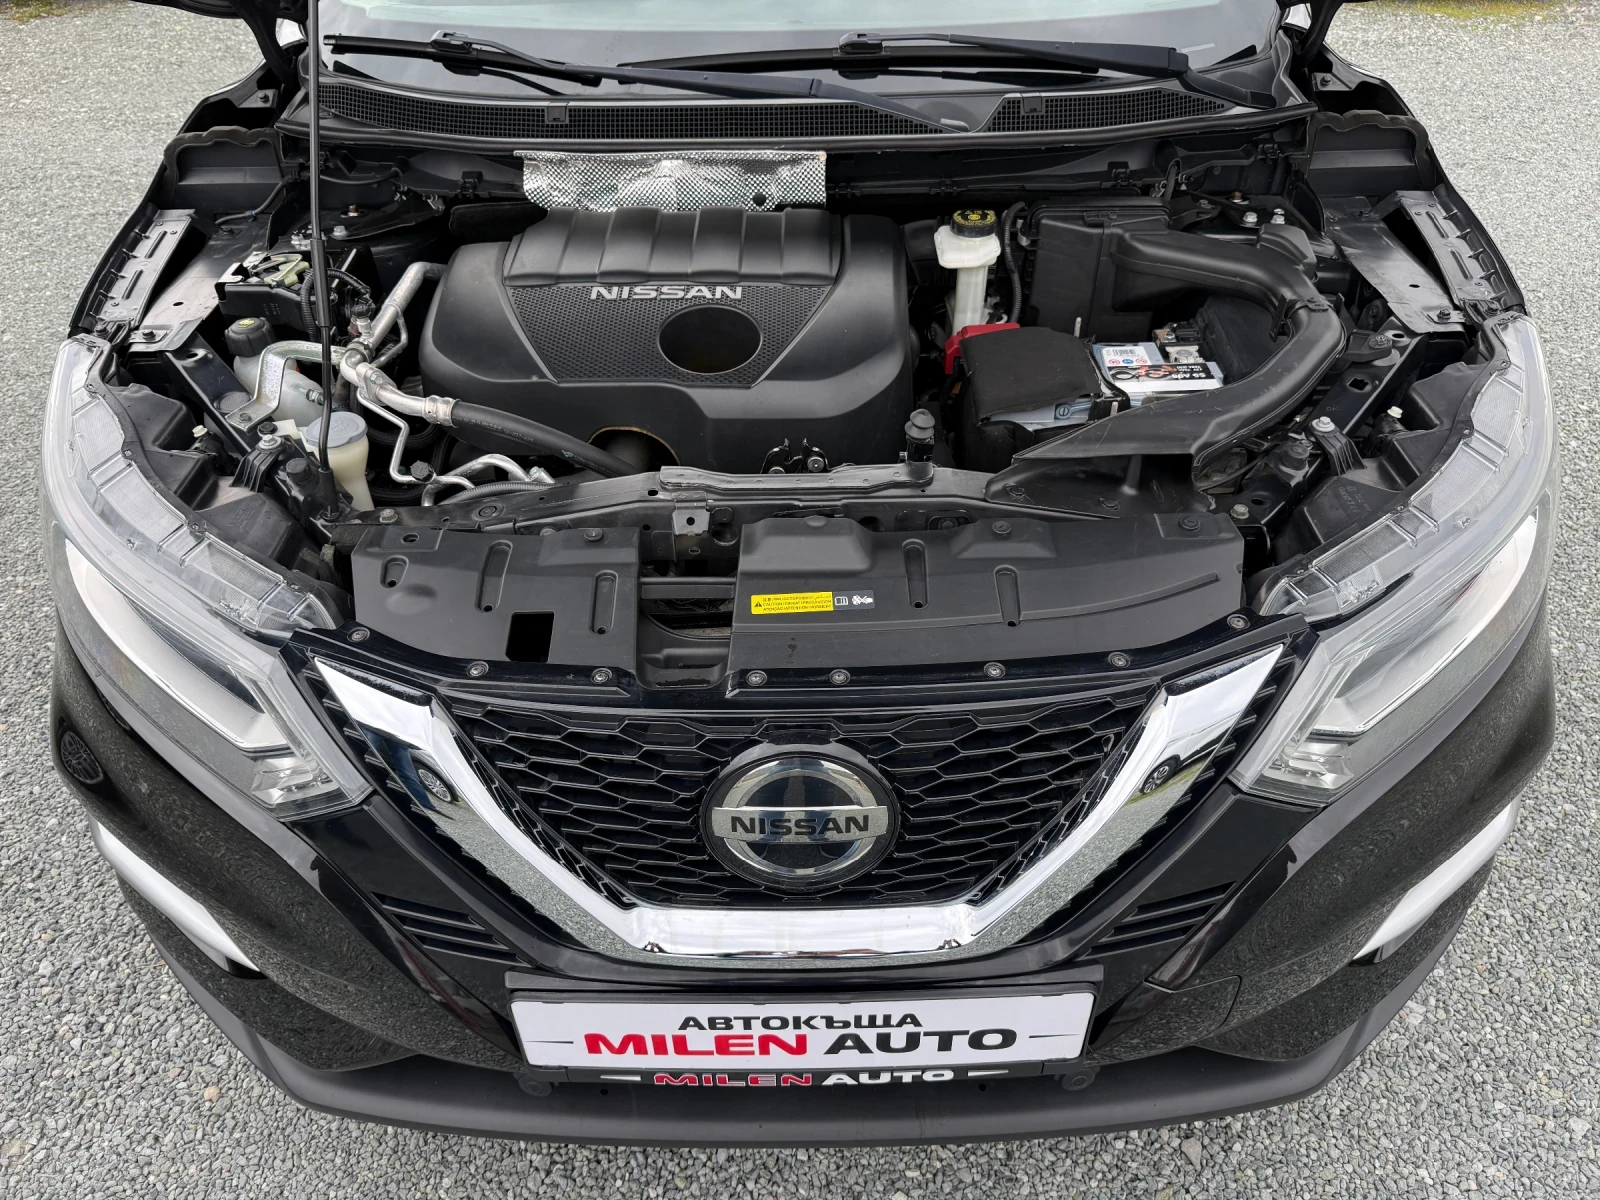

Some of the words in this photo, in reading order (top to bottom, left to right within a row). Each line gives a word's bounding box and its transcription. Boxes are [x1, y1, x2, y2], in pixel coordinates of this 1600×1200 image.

[590, 286, 743, 300] NISSAN
[731, 815, 869, 836] NISSAN
[583, 1033, 808, 1056] MILEN
[823, 1028, 1018, 1055] AUTO
[653, 1073, 812, 1087] MILEN
[821, 1068, 955, 1086] AUTO
